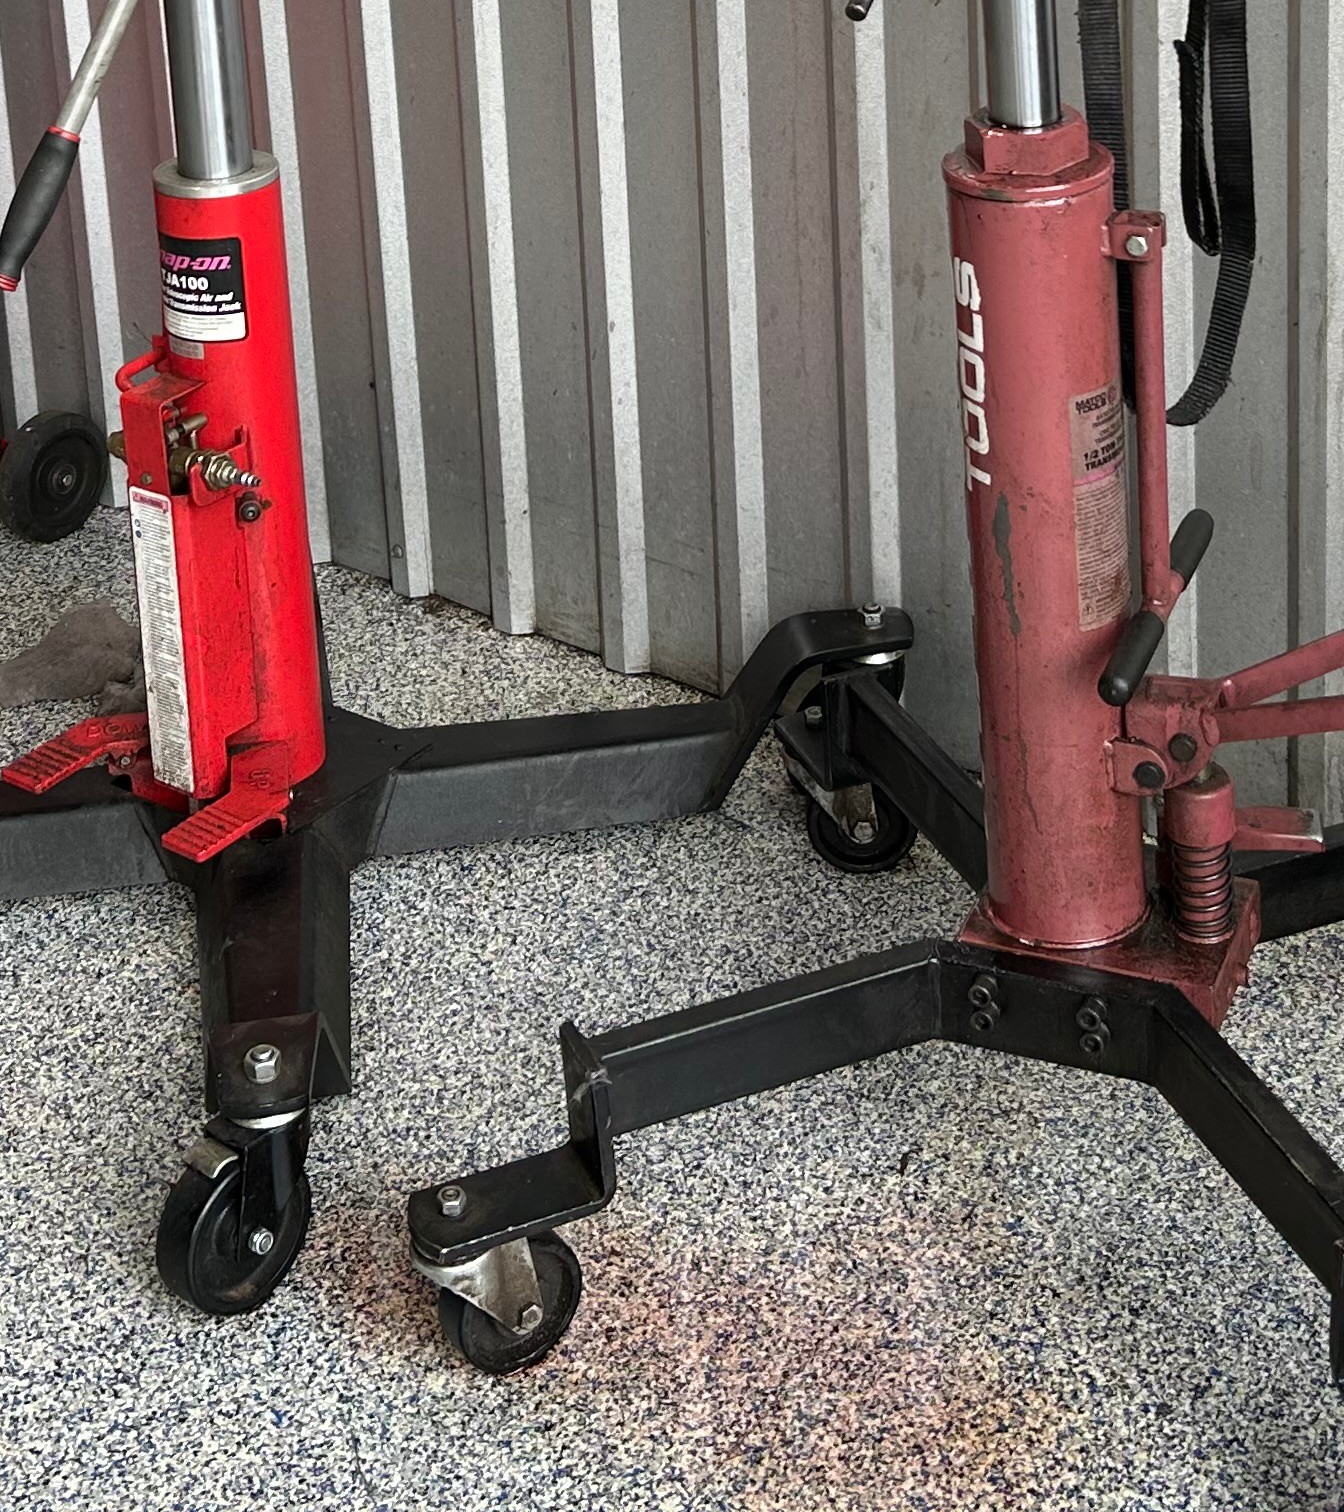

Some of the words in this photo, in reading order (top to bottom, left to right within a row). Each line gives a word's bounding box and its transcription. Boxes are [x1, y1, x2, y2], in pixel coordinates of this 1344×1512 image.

[160, 250, 231, 271] nap-on
[955, 256, 992, 492] TOOLS
[87, 722, 146, 738] DOW
